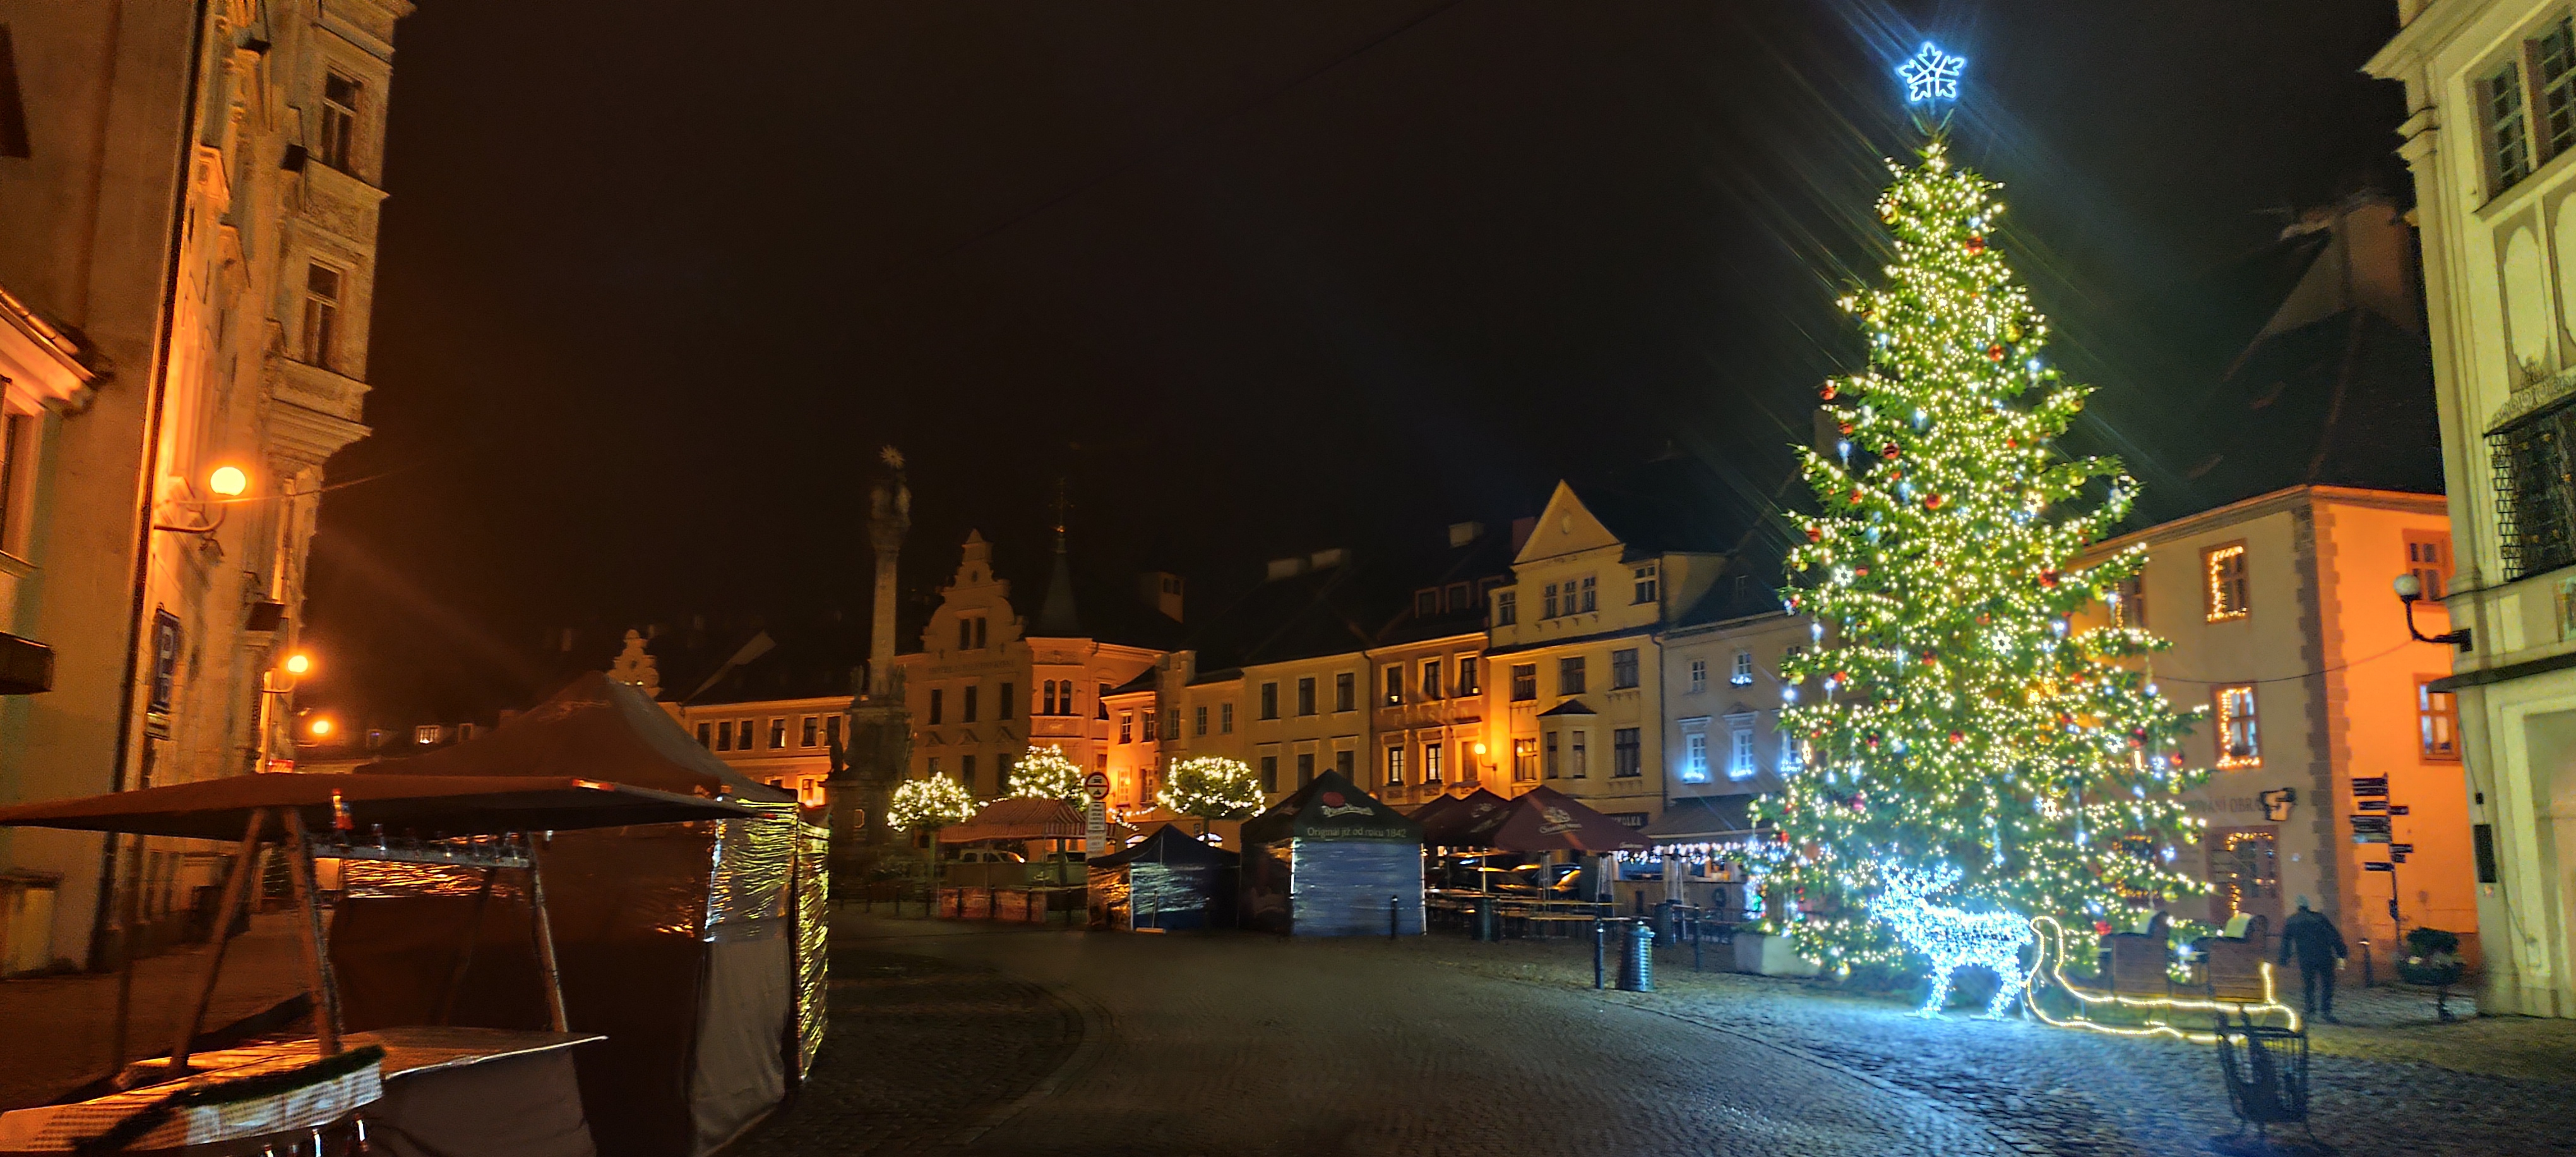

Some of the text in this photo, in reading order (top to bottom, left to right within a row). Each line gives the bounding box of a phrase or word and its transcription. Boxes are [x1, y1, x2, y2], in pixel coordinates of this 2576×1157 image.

[1307, 827, 1340, 838] Originál
[1352, 827, 1363, 836] od
[1365, 827, 1383, 837] roku
[1386, 828, 1407, 837] 1842
